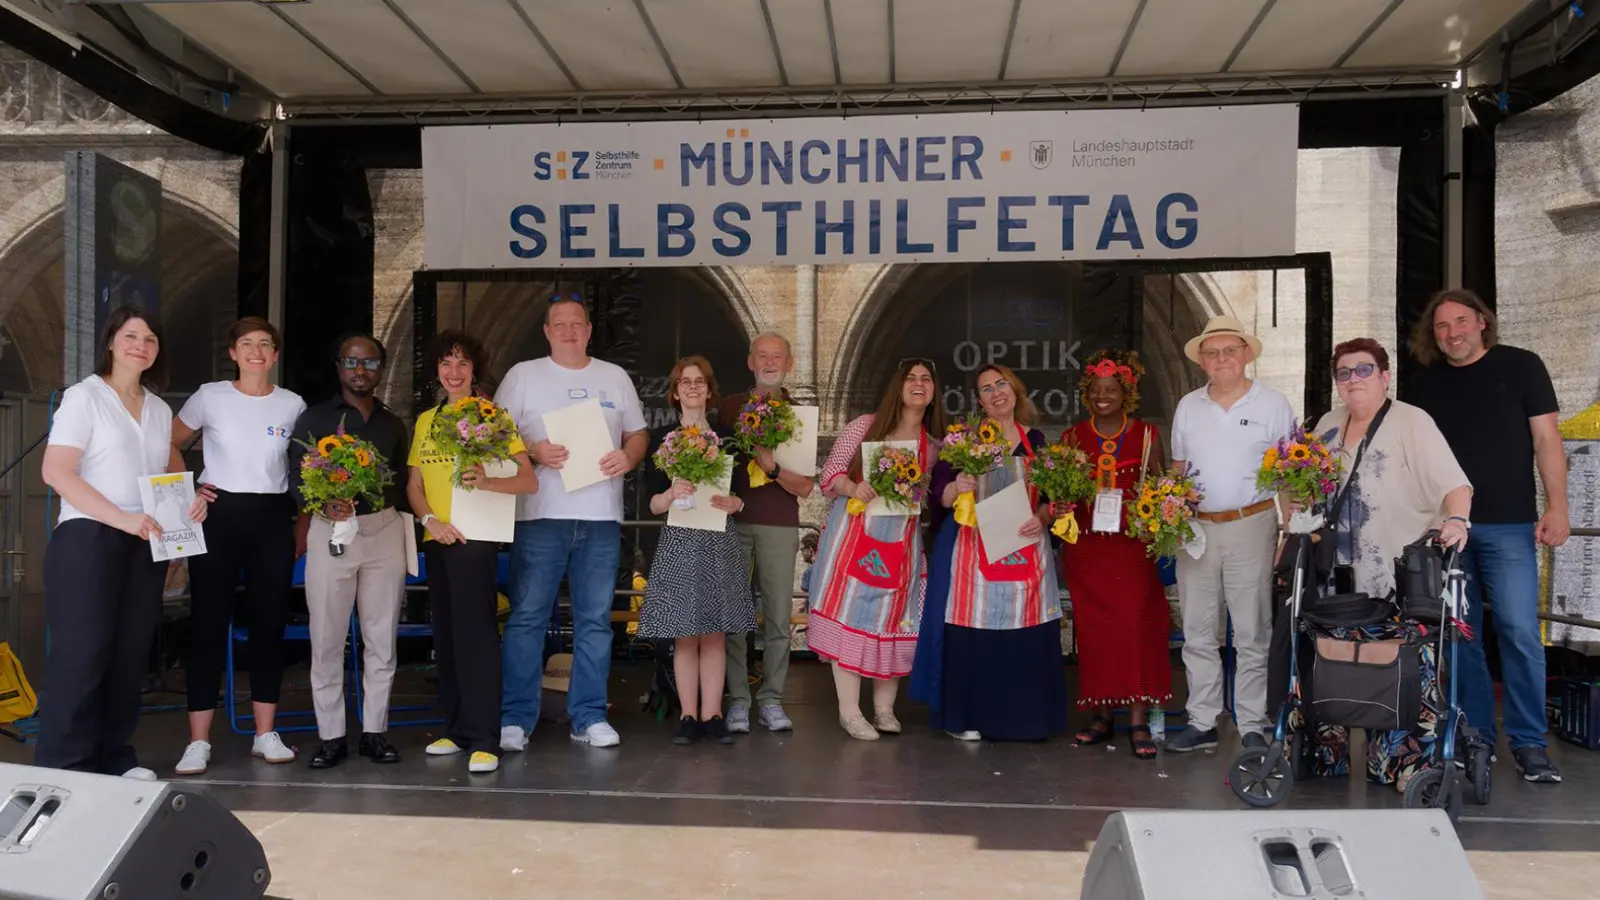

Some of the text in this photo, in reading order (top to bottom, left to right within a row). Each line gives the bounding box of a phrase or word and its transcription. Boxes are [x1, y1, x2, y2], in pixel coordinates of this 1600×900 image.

[1072, 138, 1195, 154] Landeshauptstadt
[595, 150, 640, 161] Selbsthilfe
[680, 128, 984, 187] MÜNCHNER
[1071, 154, 1136, 169] München
[595, 161, 632, 170] Zentrum
[595, 170, 633, 180] München
[508, 192, 1199, 259] SELBSTHILFETAG
[953, 340, 1082, 372] OPTIK
